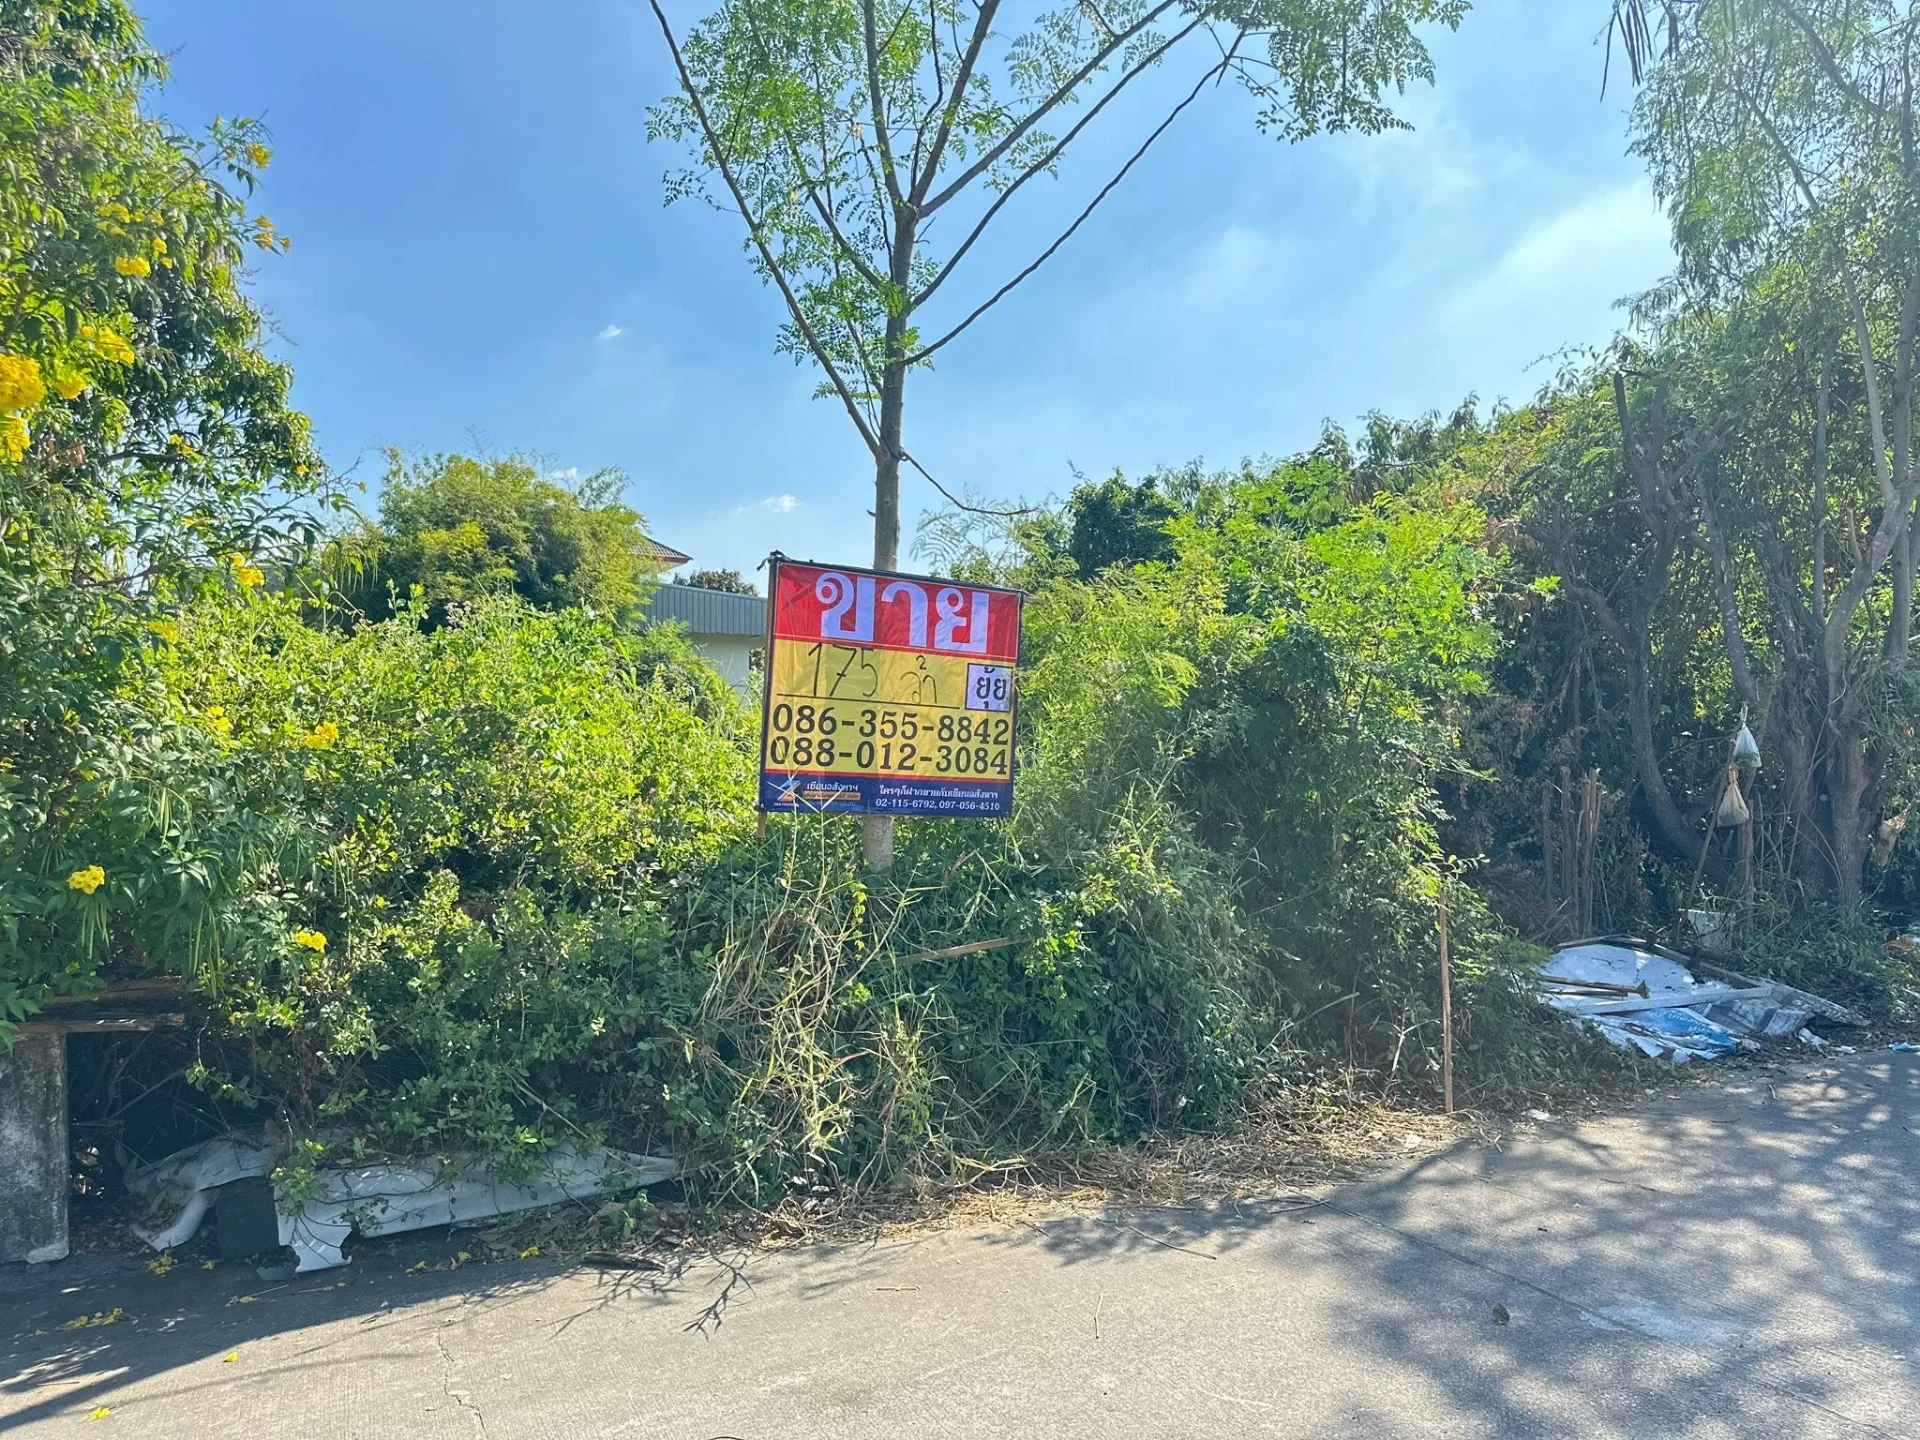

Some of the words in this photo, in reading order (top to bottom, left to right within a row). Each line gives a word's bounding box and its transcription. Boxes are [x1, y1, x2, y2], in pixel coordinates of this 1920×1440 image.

[816, 572, 989, 653] ขาย
[808, 641, 879, 697] 175
[773, 704, 1009, 745] 086-355-8842
[770, 736, 1007, 775] 088-012-3084
